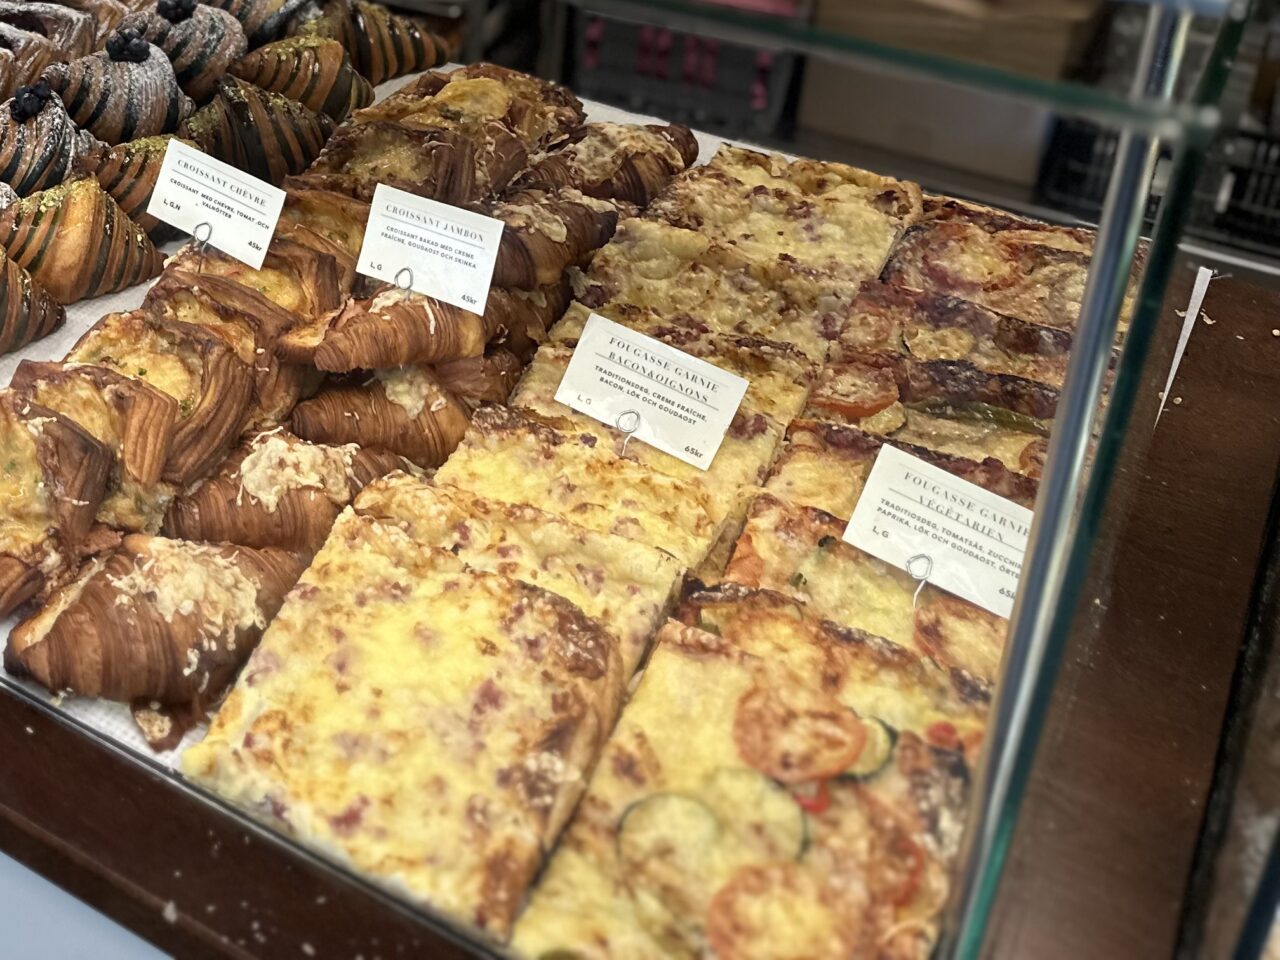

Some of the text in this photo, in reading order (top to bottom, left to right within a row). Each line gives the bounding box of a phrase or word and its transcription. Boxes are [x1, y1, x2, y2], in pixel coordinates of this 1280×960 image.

[170, 178, 198, 195] CROISSANT
[201, 193, 212, 202] MED
[236, 210, 254, 223] TOMAT
[177, 159, 267, 207] CROISSANT CHÈVRE
[202, 201, 231, 219] VALNÖTTER
[385, 204, 484, 242] CROISSANT JAMBON
[248, 240, 262, 252] 45kr
[386, 225, 473, 260] CROISSANT BAKAD MED CREME
[408, 241, 438, 256] GOUDAOST
[440, 252, 452, 261] OCH
[454, 257, 476, 269] SKINKA
[377, 263, 382, 271] G
[461, 293, 477, 305] 45kr
[608, 336, 719, 393] FOUGASSE GARNIE
[608, 351, 709, 403] BACON&OIGNONS
[594, 365, 650, 395] TRADITIONSDEG,
[652, 392, 675, 406] CREME
[599, 376, 696, 426] BACON, LÖK OCH GOUDAOST
[684, 445, 703, 459] 65kr
[903, 471, 976, 511] FOUGASSE
[876, 506, 911, 528] PAPRIKA,
[914, 523, 929, 536] LÖK
[931, 533, 948, 545] OCH
[950, 542, 996, 569] GOUDAOST,
[881, 530, 889, 539] G
